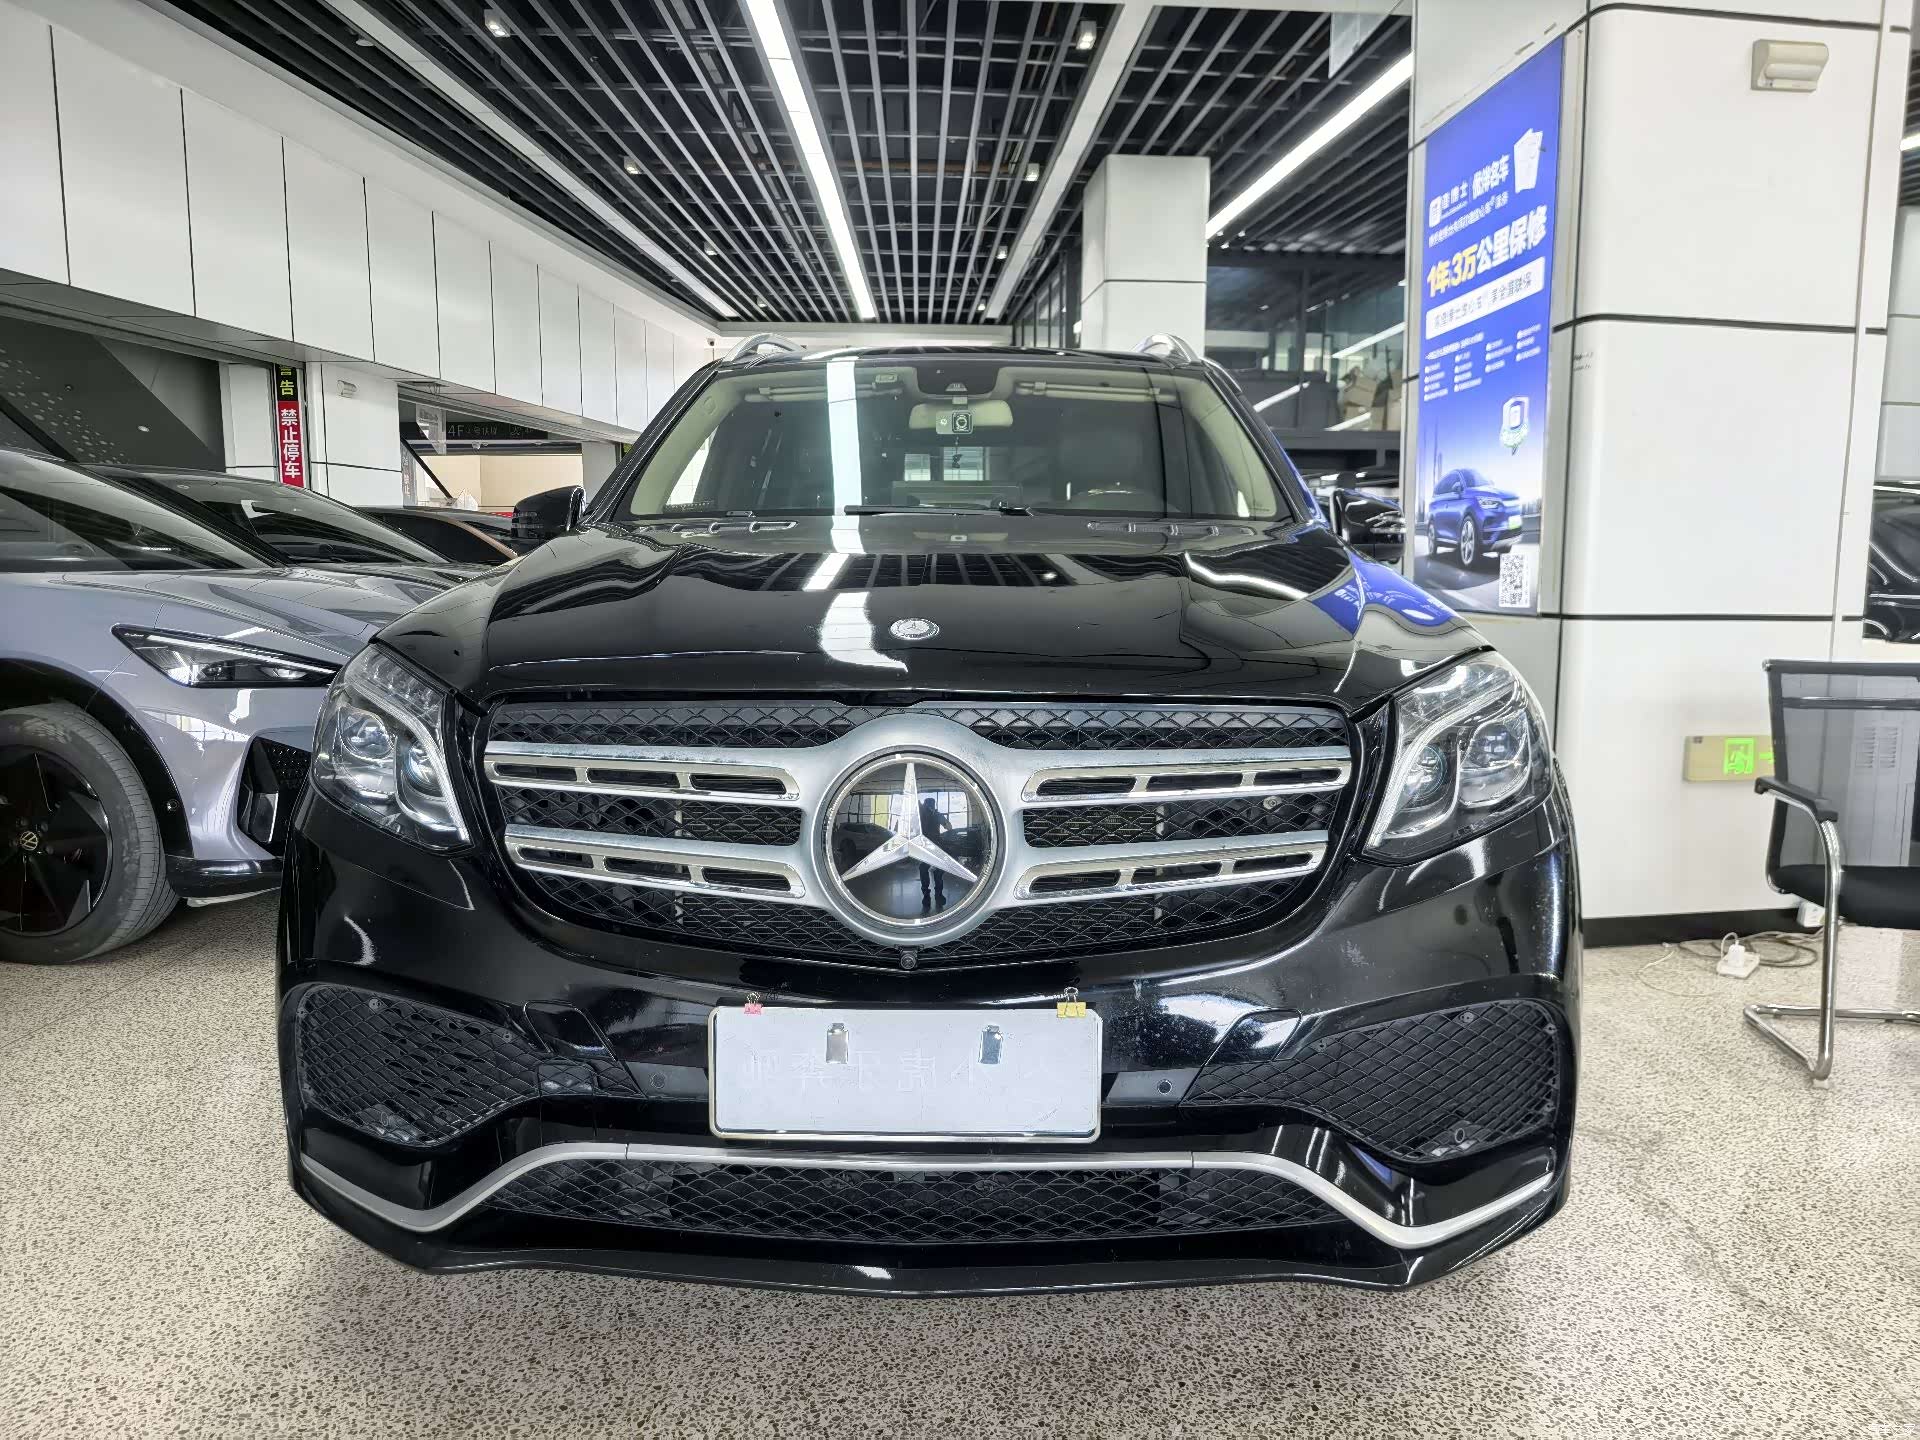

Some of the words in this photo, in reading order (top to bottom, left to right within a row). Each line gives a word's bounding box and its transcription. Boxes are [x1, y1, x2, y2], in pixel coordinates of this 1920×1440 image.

[280, 408, 301, 479] 禁止停车
[448, 425, 464, 437] 4F
